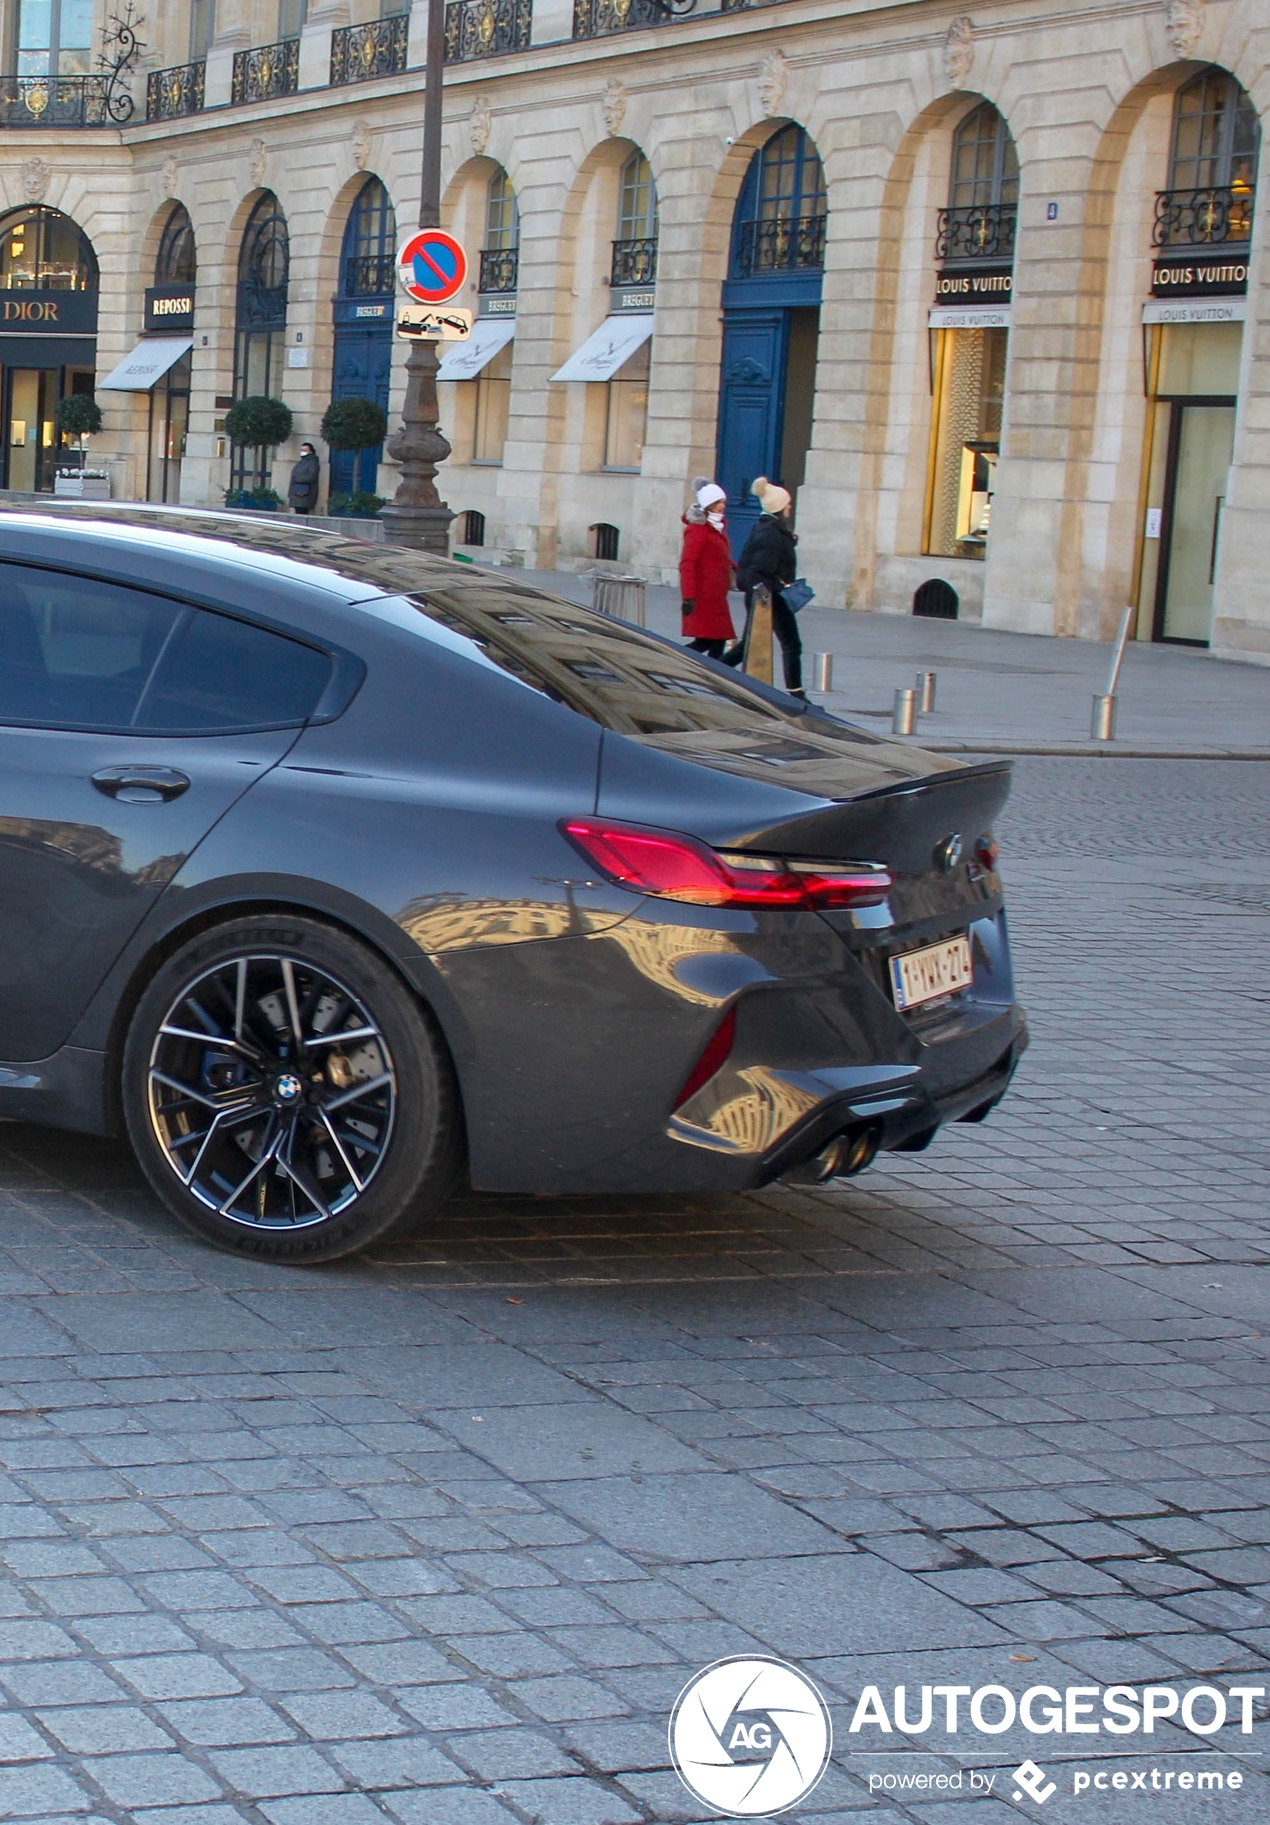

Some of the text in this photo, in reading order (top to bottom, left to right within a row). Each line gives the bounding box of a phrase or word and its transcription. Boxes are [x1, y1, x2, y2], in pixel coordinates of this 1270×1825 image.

[936, 276, 1012, 294] LOUIS VUITTO
[1153, 268, 1193, 285] LOUIS
[3, 301, 59, 321] DIOR
[152, 297, 191, 315] REPOSSI
[1158, 308, 1234, 321] LOUIS VUITTON
[942, 314, 1005, 326] LOUIS VUITTON
